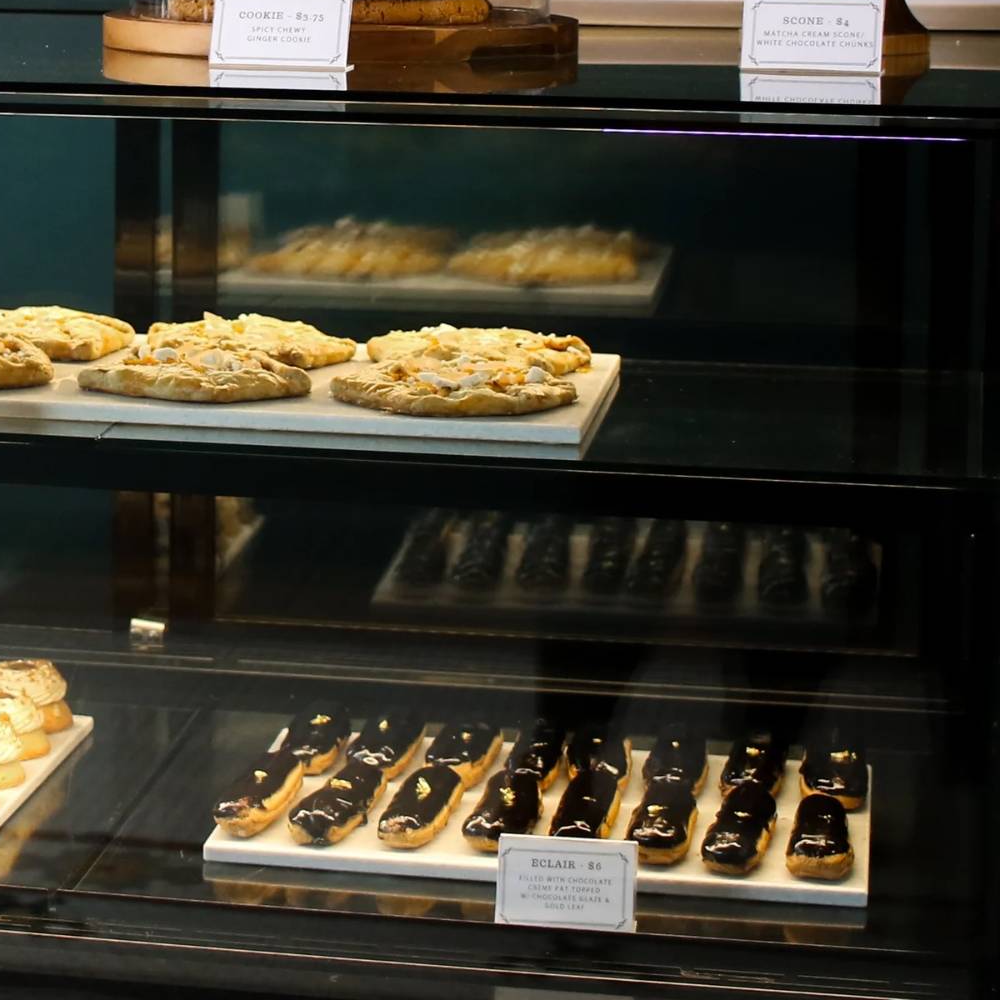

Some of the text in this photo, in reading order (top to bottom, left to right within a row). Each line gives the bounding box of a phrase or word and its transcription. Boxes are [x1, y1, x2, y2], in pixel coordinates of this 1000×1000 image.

[238, 10, 284, 20] COOKIE
[782, 16, 850, 28] SCONE $4
[839, 40, 874, 48] CHUNKS
[531, 858, 602, 871] ECLAIR $6
[568, 876, 612, 886] CHOCOLATE
[572, 886, 600, 894] TOPPED
